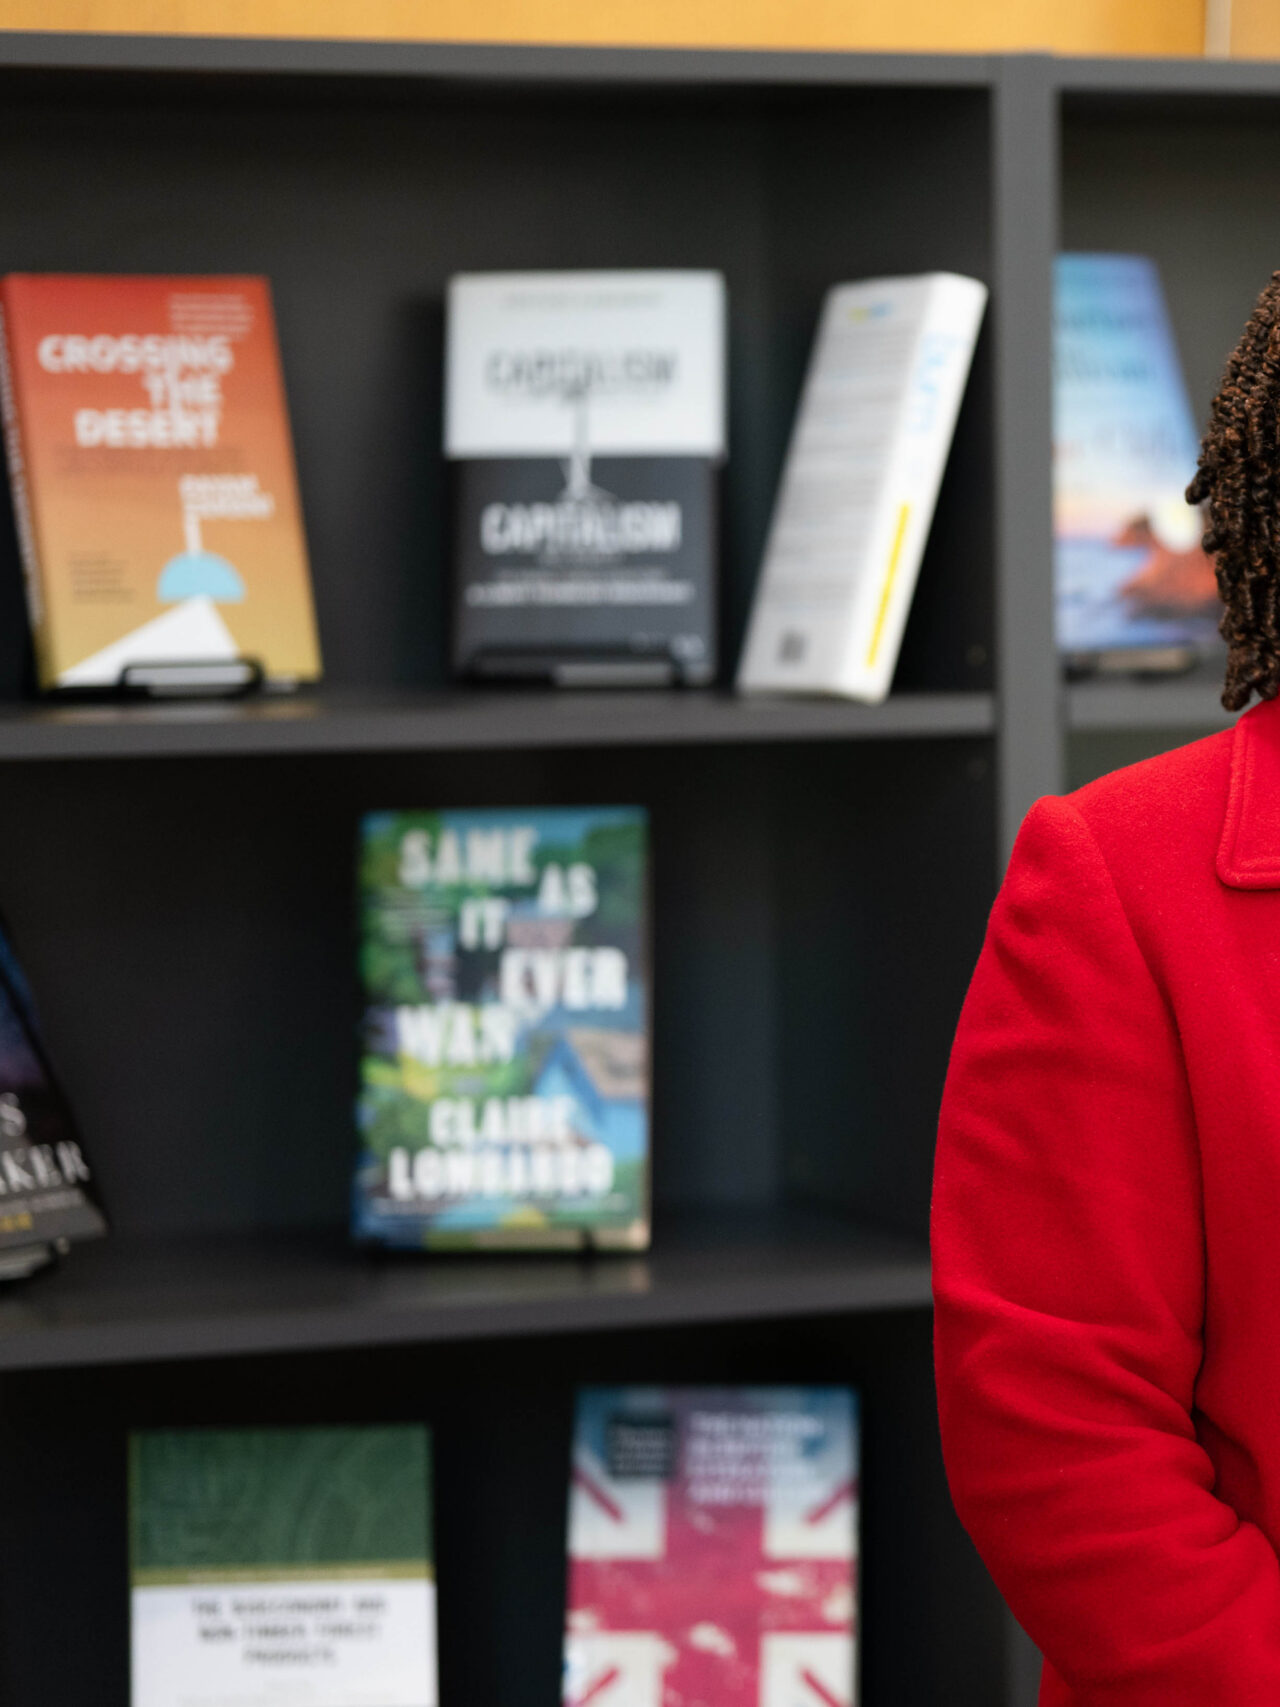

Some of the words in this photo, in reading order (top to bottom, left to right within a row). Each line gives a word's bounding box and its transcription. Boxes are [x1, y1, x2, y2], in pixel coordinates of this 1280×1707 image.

[38, 334, 234, 373] CROSSING
[144, 371, 222, 409] THE
[74, 408, 219, 448] DESERT
[481, 502, 682, 554] CAPITALISM
[399, 827, 538, 886] SAME
[537, 862, 599, 917] AS
[459, 897, 507, 950] IT
[501, 946, 629, 1010] EVER
[429, 1096, 574, 1149] CLAIRE
